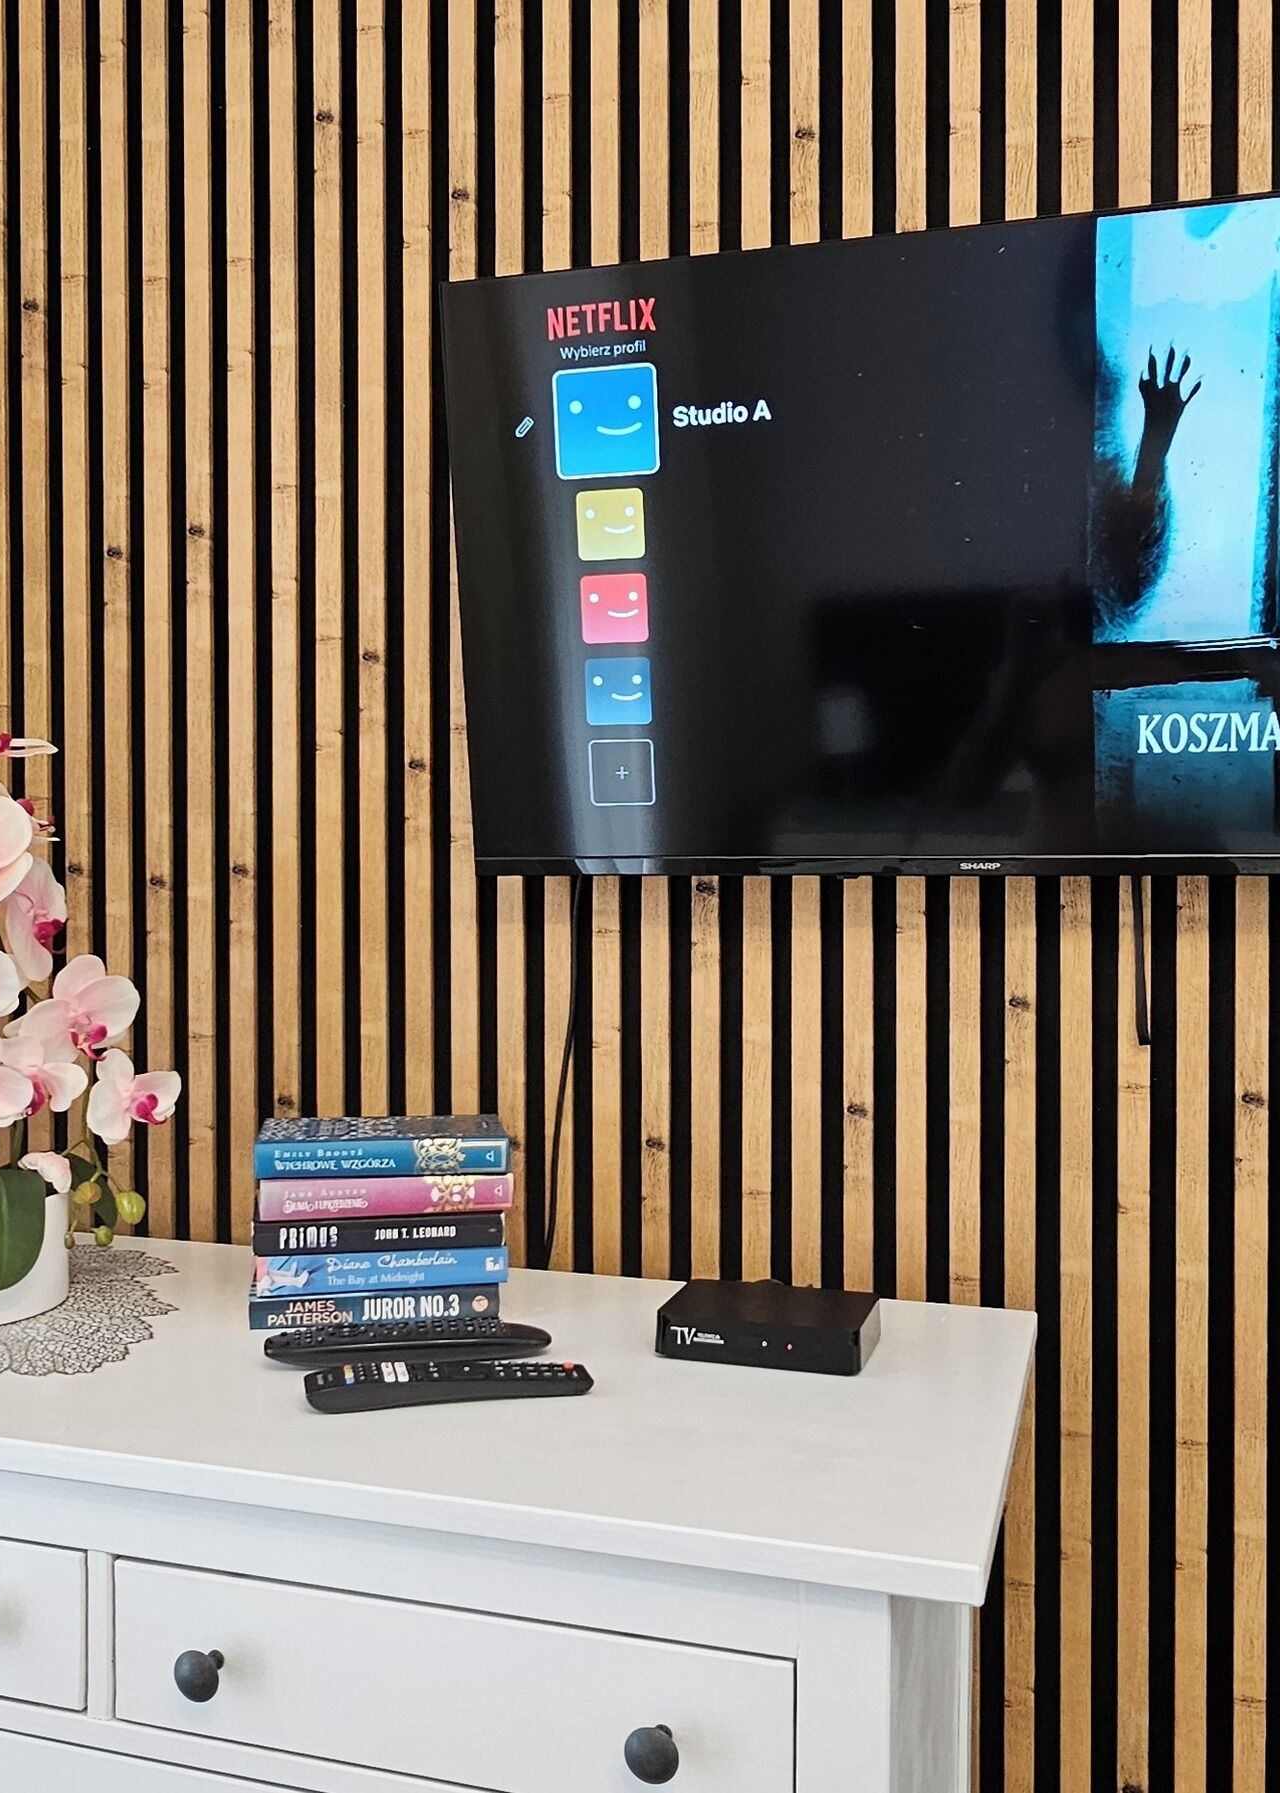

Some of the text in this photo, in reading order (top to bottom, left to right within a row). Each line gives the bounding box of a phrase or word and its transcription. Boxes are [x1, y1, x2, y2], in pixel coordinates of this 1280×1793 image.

[547, 298, 656, 341] NETFLIX
[559, 340, 647, 361] Wybierz profil
[672, 399, 772, 428] Studio A
[959, 862, 1001, 870] SHARP
[341, 1158, 397, 1170] WZGÓRZA
[374, 1228, 399, 1241] JOHN
[402, 1227, 410, 1239] T.
[413, 1226, 456, 1239] LEONARD
[326, 1251, 458, 1272] Diane Chamberlain
[327, 1271, 425, 1287] The Bay at Midnight
[285, 1300, 336, 1314] JAMES
[362, 1294, 460, 1321] JUROR NO.3
[267, 1311, 353, 1326] PATTERSON
[670, 1326, 696, 1345] TV
